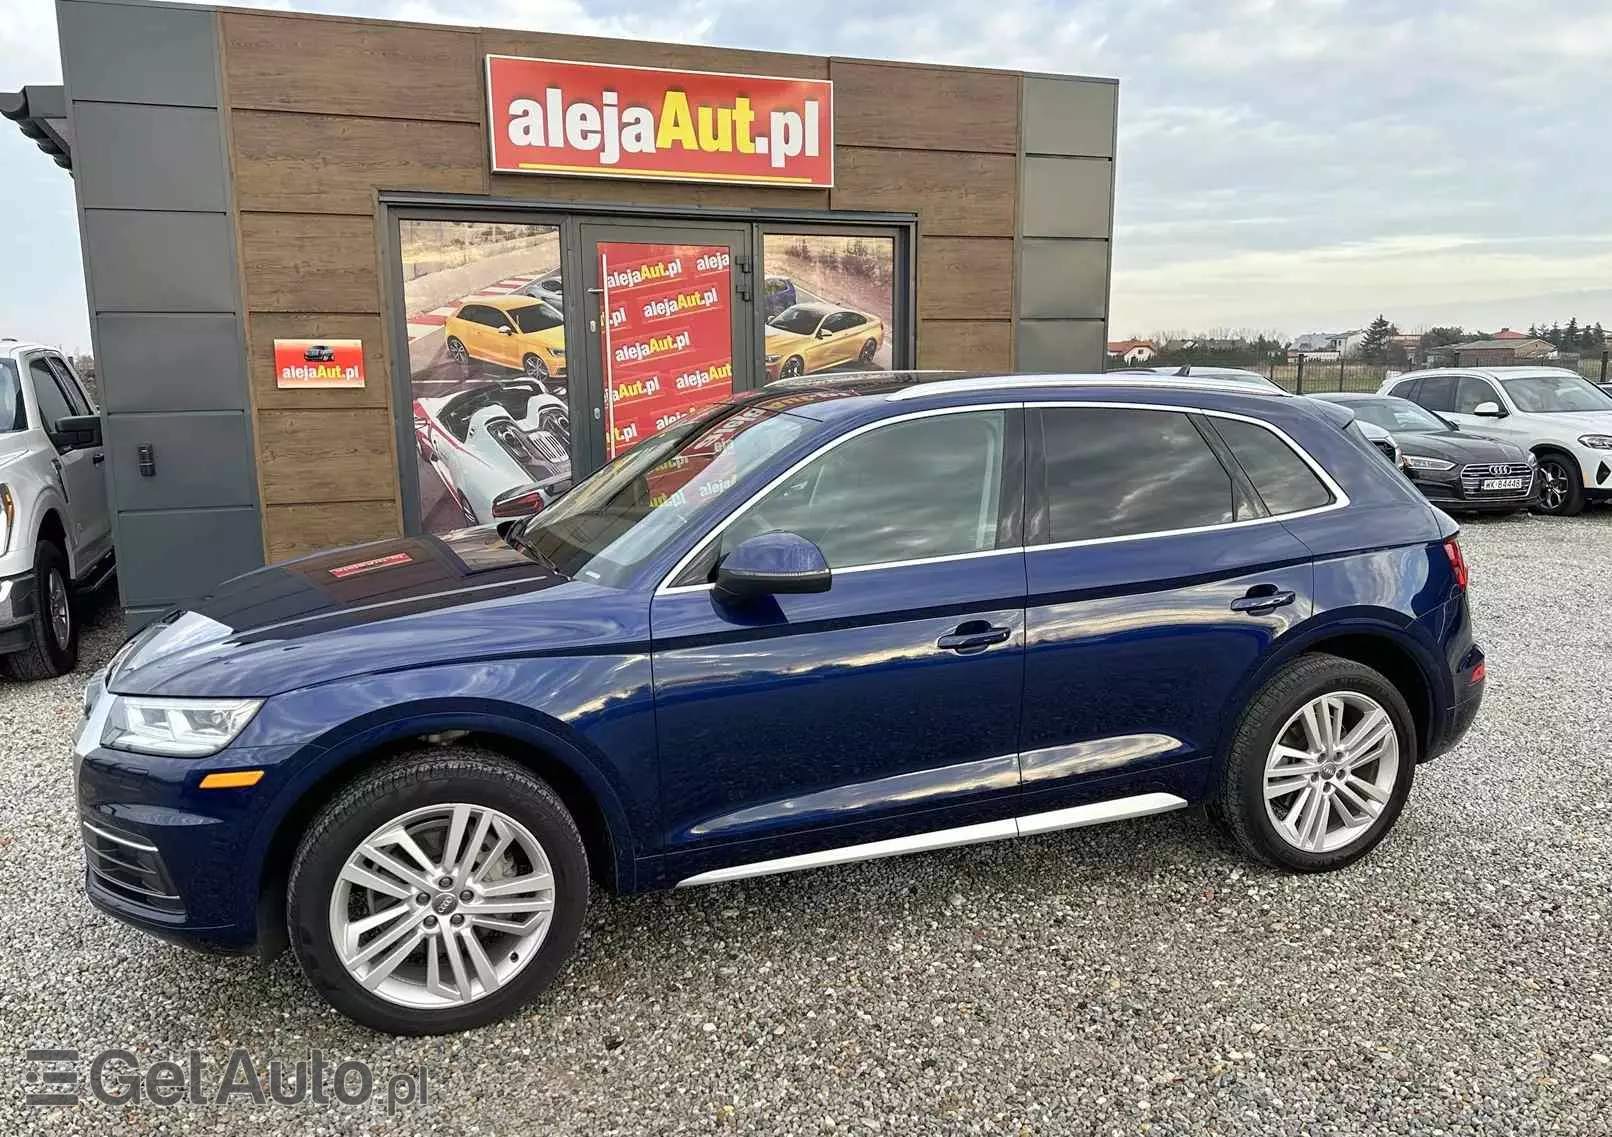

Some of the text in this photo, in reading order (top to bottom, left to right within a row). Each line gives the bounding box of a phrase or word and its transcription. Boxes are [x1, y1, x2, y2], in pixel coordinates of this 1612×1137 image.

[508, 87, 820, 168] alejaAut.pl
[607, 259, 682, 289] alejaAut.pl
[643, 287, 718, 319] alejaAut.pl
[615, 331, 690, 362] alejaAut.pl
[282, 365, 359, 380] alejaAut.pl
